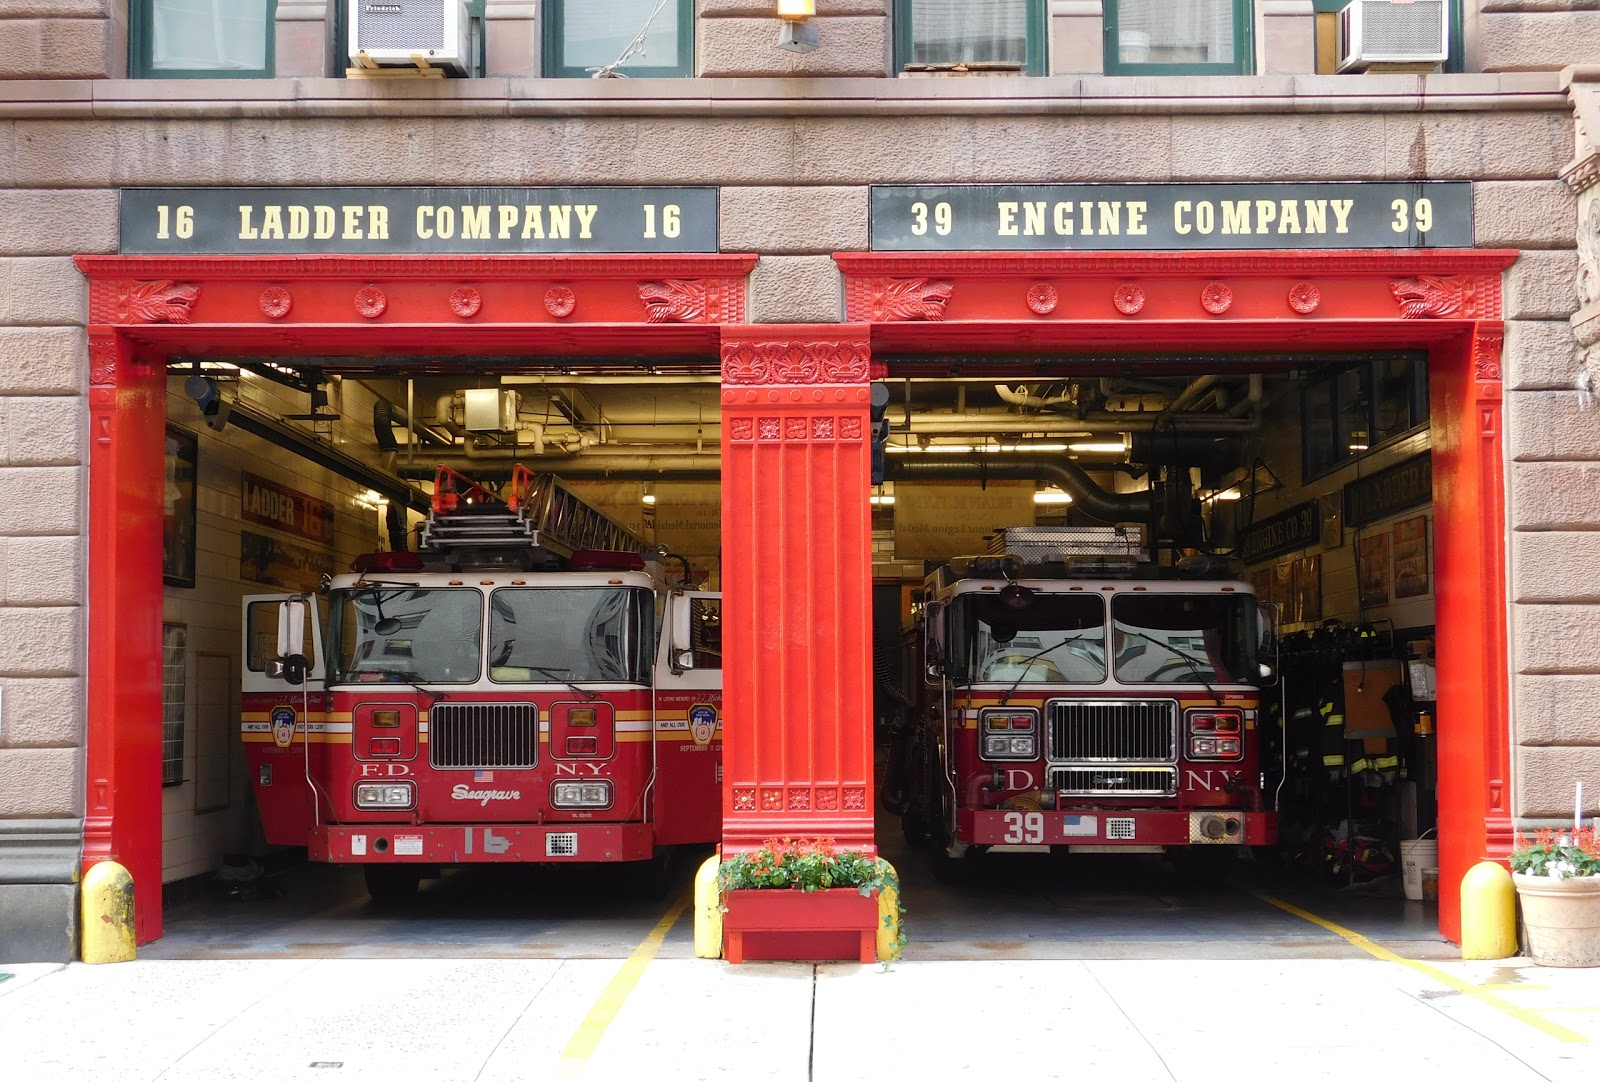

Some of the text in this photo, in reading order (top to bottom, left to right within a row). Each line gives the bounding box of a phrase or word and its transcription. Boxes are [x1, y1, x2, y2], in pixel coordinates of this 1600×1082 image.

[157, 204, 681, 239] 16 LADDER COMPANY 16
[911, 198, 1433, 236] 39 ENGINE COMPANY 39
[243, 481, 321, 536] LADDER 16
[1301, 507, 1313, 538] 39
[360, 764, 415, 776] F.D.
[554, 763, 611, 776] N.Y.
[451, 784, 521, 807] Seagrave
[1004, 812, 1044, 844] 39
